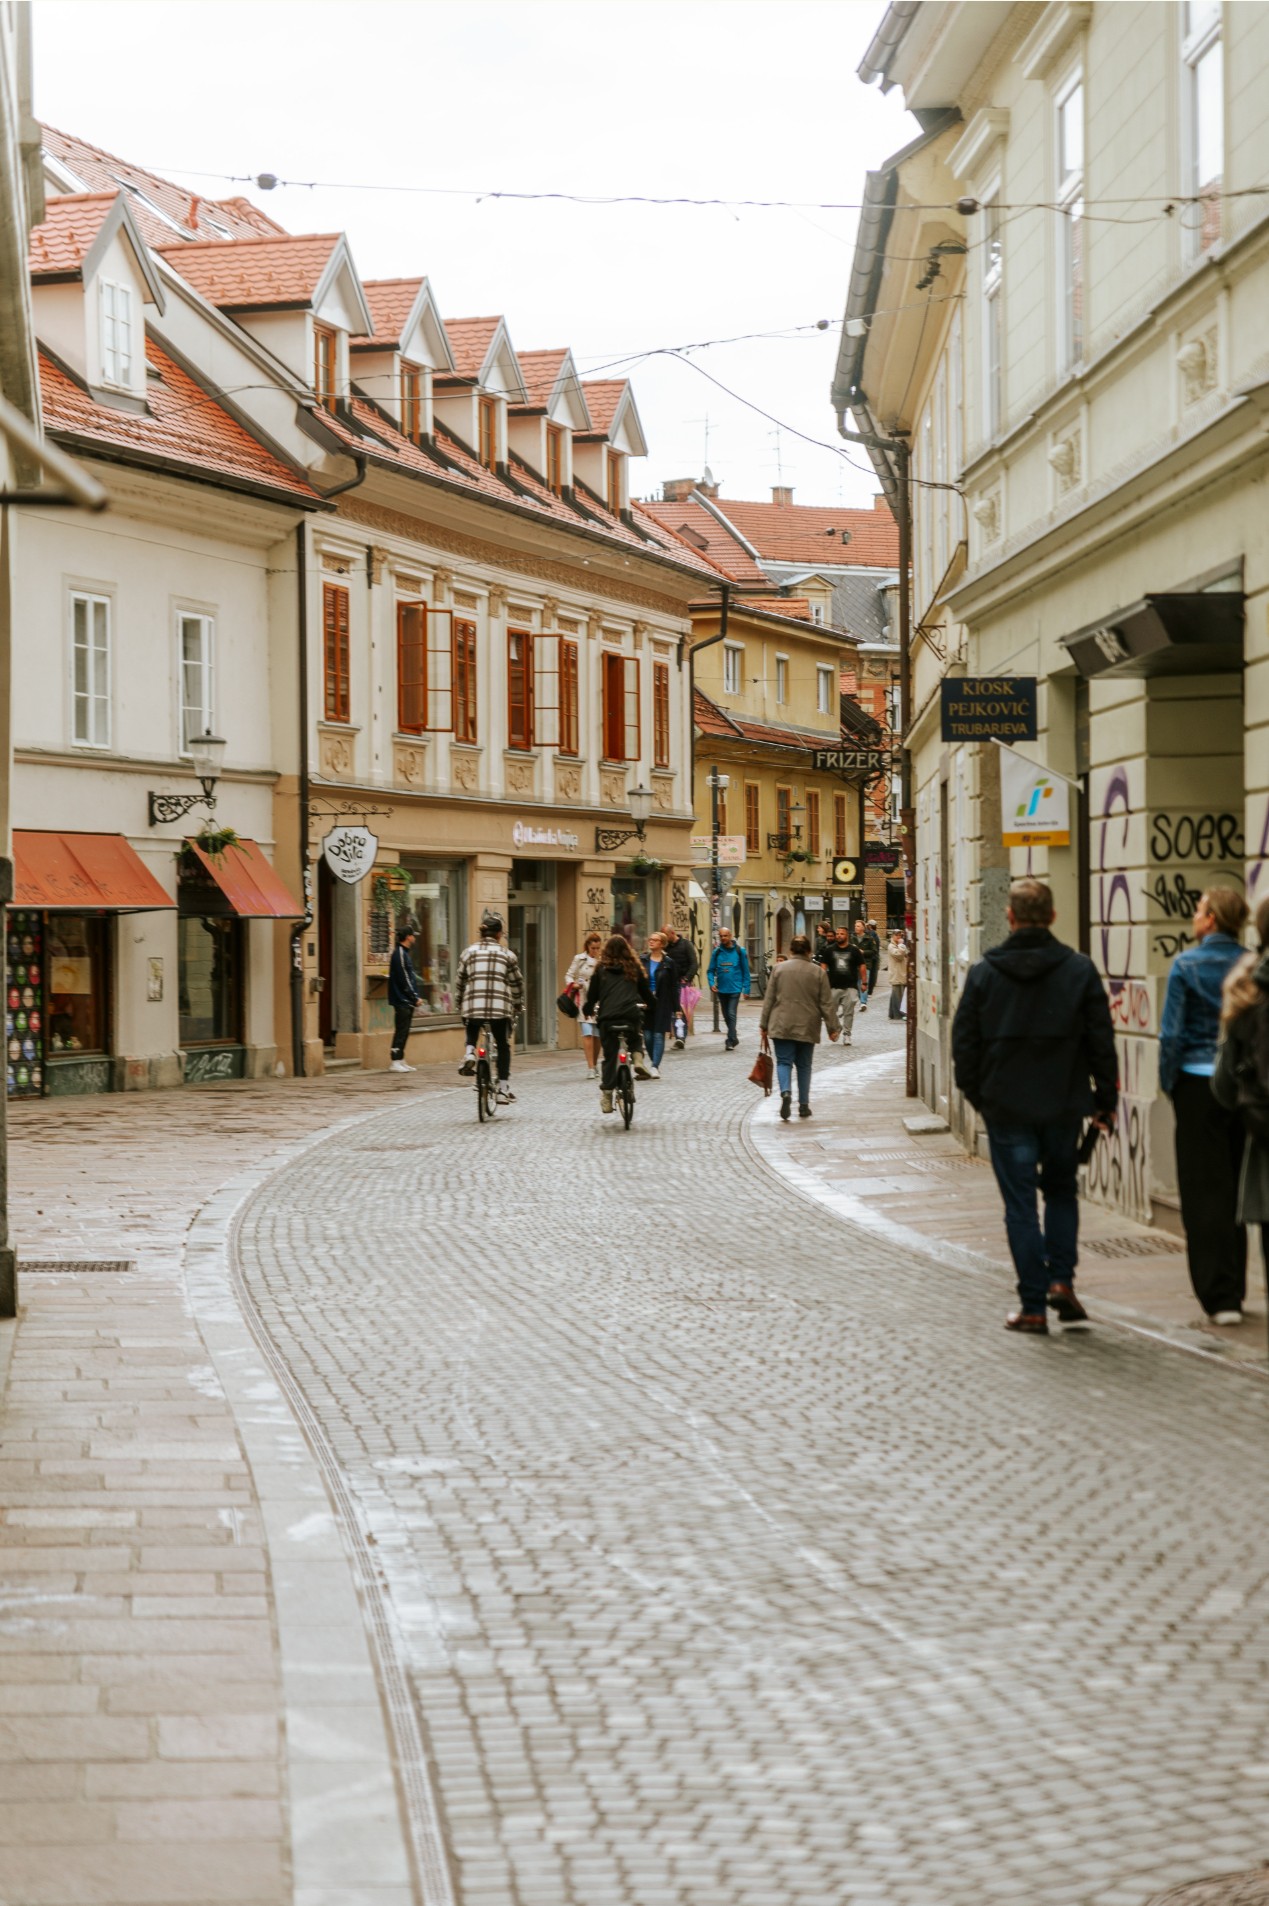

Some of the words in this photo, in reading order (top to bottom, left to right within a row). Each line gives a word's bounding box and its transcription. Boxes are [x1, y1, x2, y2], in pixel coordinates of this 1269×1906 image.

[962, 681, 1015, 695] KIOSK
[950, 723, 1028, 735] TRUBARJEVA
[816, 752, 880, 768] FRIZER
[328, 832, 367, 857] Dobra
